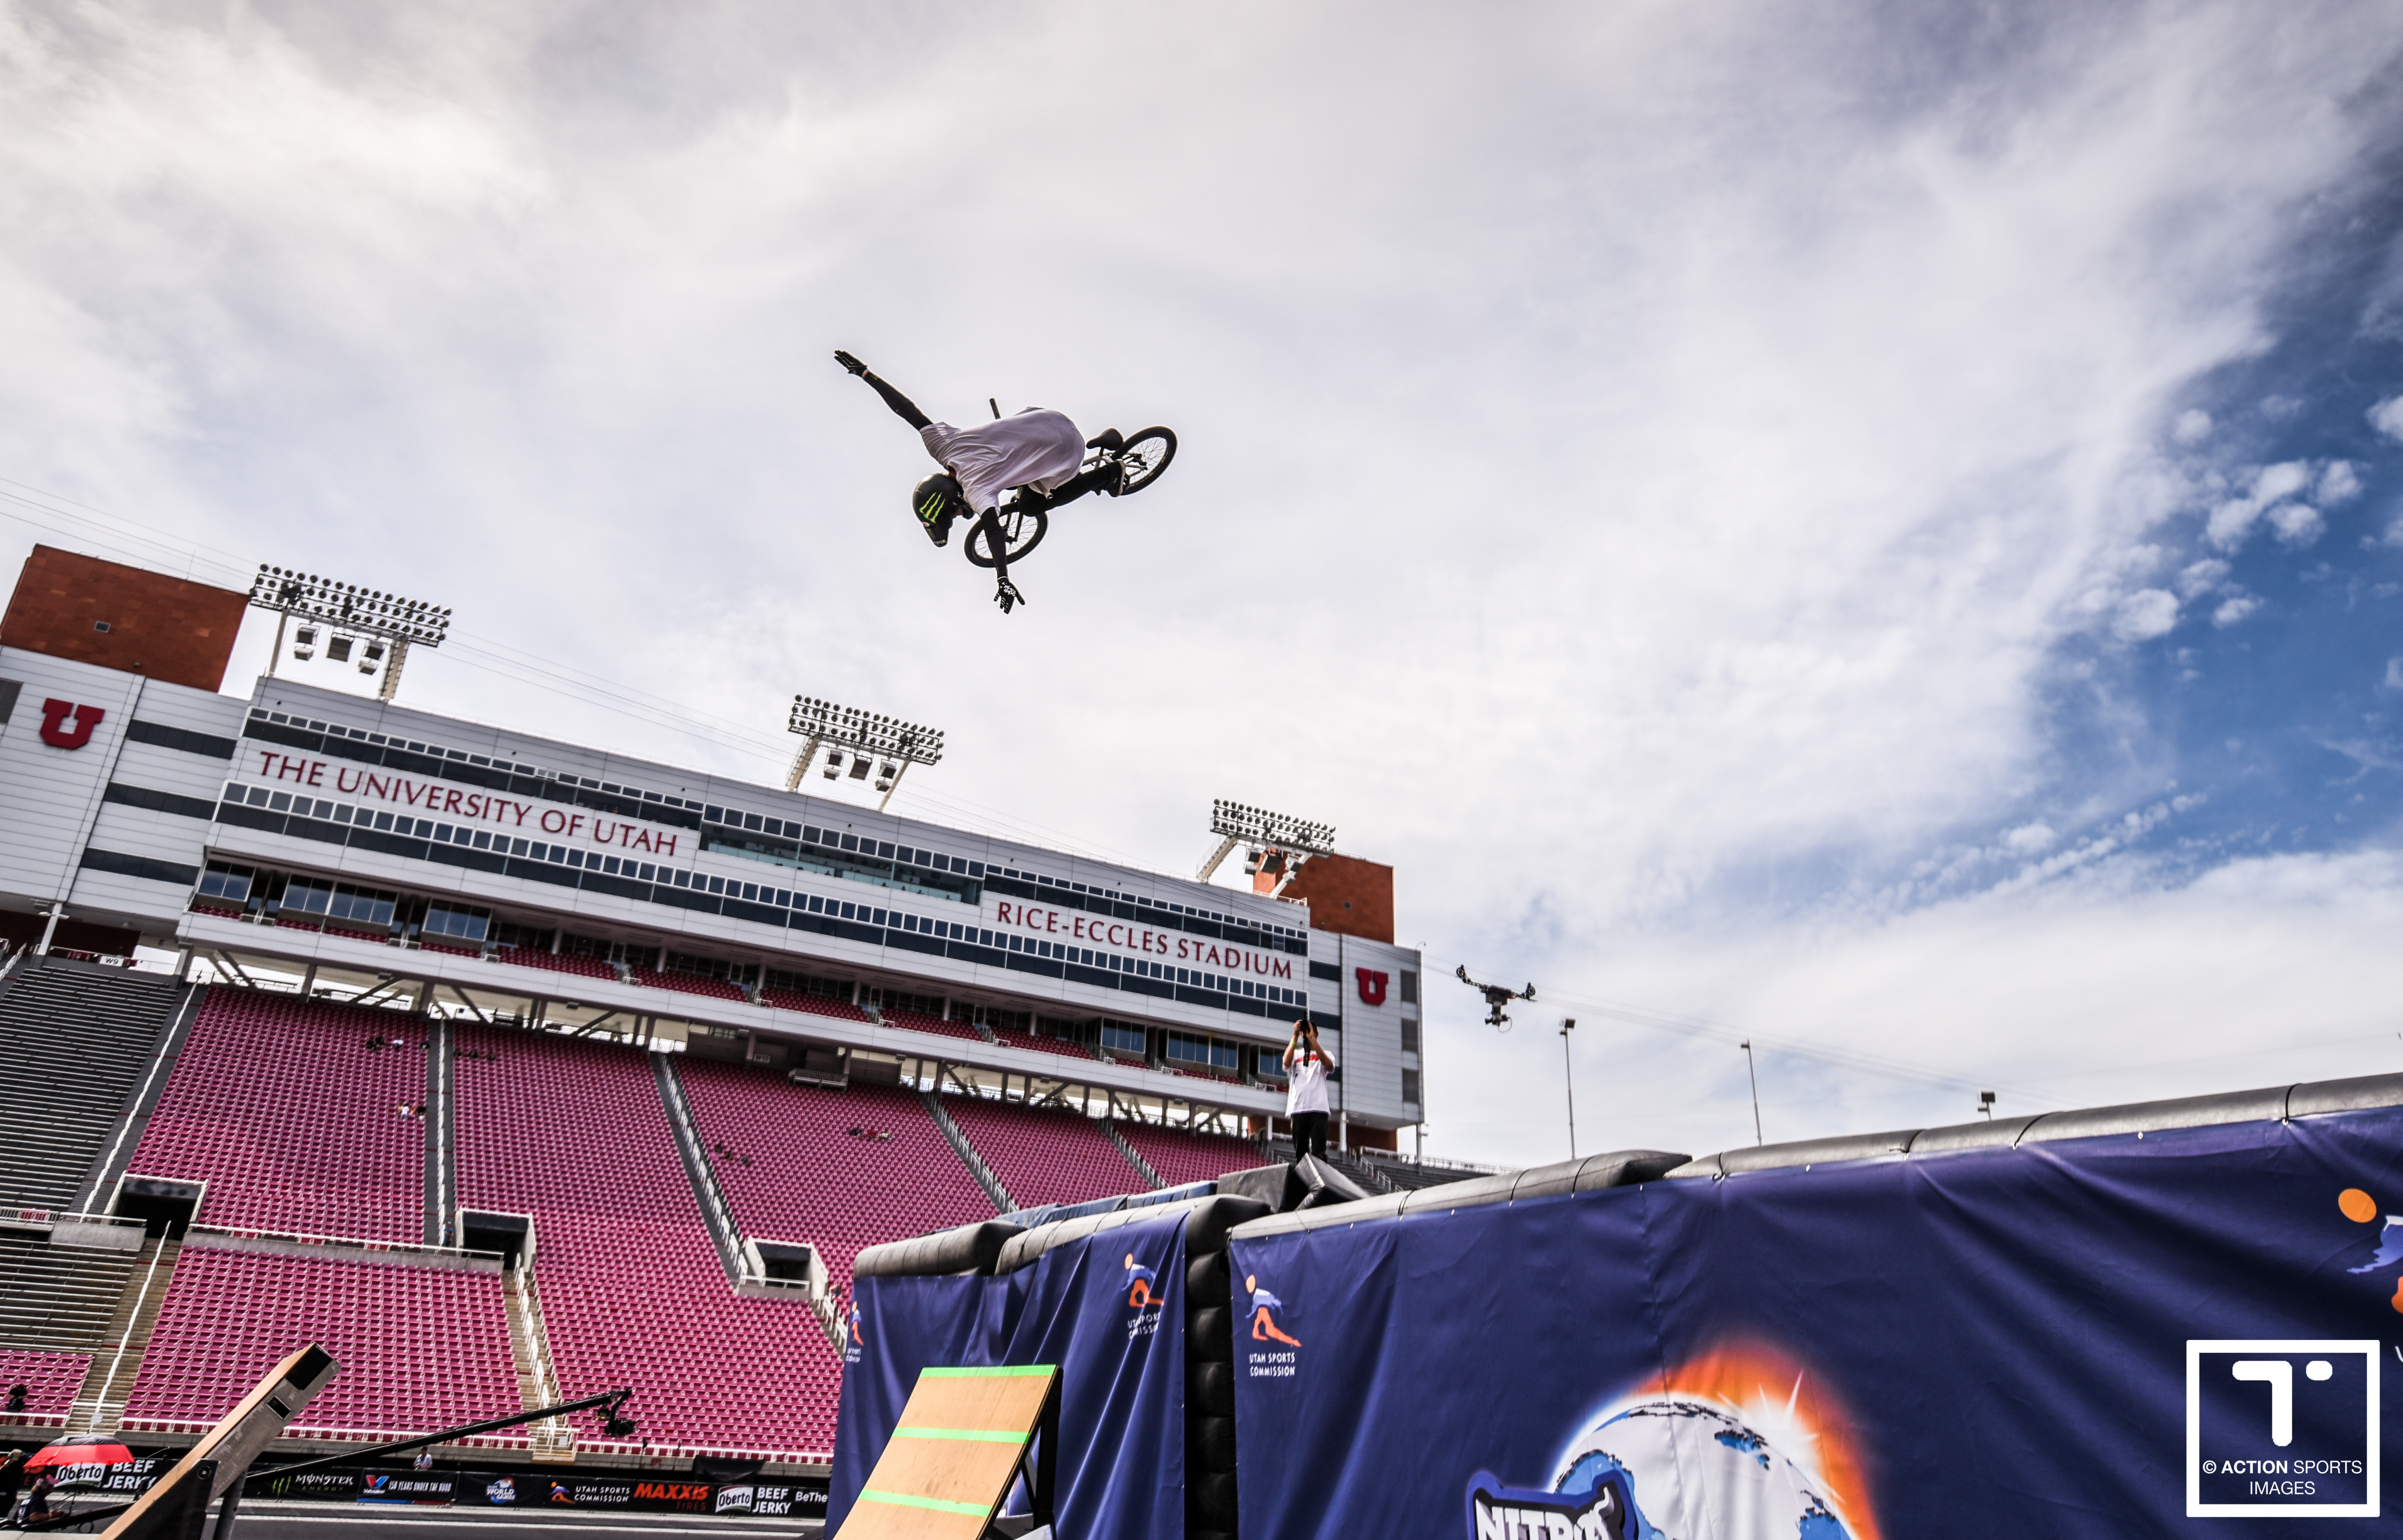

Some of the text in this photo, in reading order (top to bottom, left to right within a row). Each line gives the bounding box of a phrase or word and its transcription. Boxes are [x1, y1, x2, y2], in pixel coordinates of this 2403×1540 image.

[40, 697, 105, 750] U
[260, 751, 677, 856] THE UNIVERSITY OF UTAH
[998, 902, 1292, 979] RICE-ECCLES STADIUM
[106, 957, 119, 965] W9
[1356, 966, 1389, 1006] U
[1249, 1352, 1296, 1364] UTAH SPORTS
[1250, 1366, 1296, 1377] COMMISSION
[295, 1473, 354, 1485] MONSTER
[398, 1481, 414, 1491] YEARS
[633, 1483, 710, 1500] MAXXIS
[574, 1494, 630, 1502] COMMISSION
[718, 1492, 751, 1507] Oberto
[757, 1487, 789, 1500] BEEF
[676, 1502, 706, 1511] TIRES
[752, 1501, 792, 1514] JERKY
